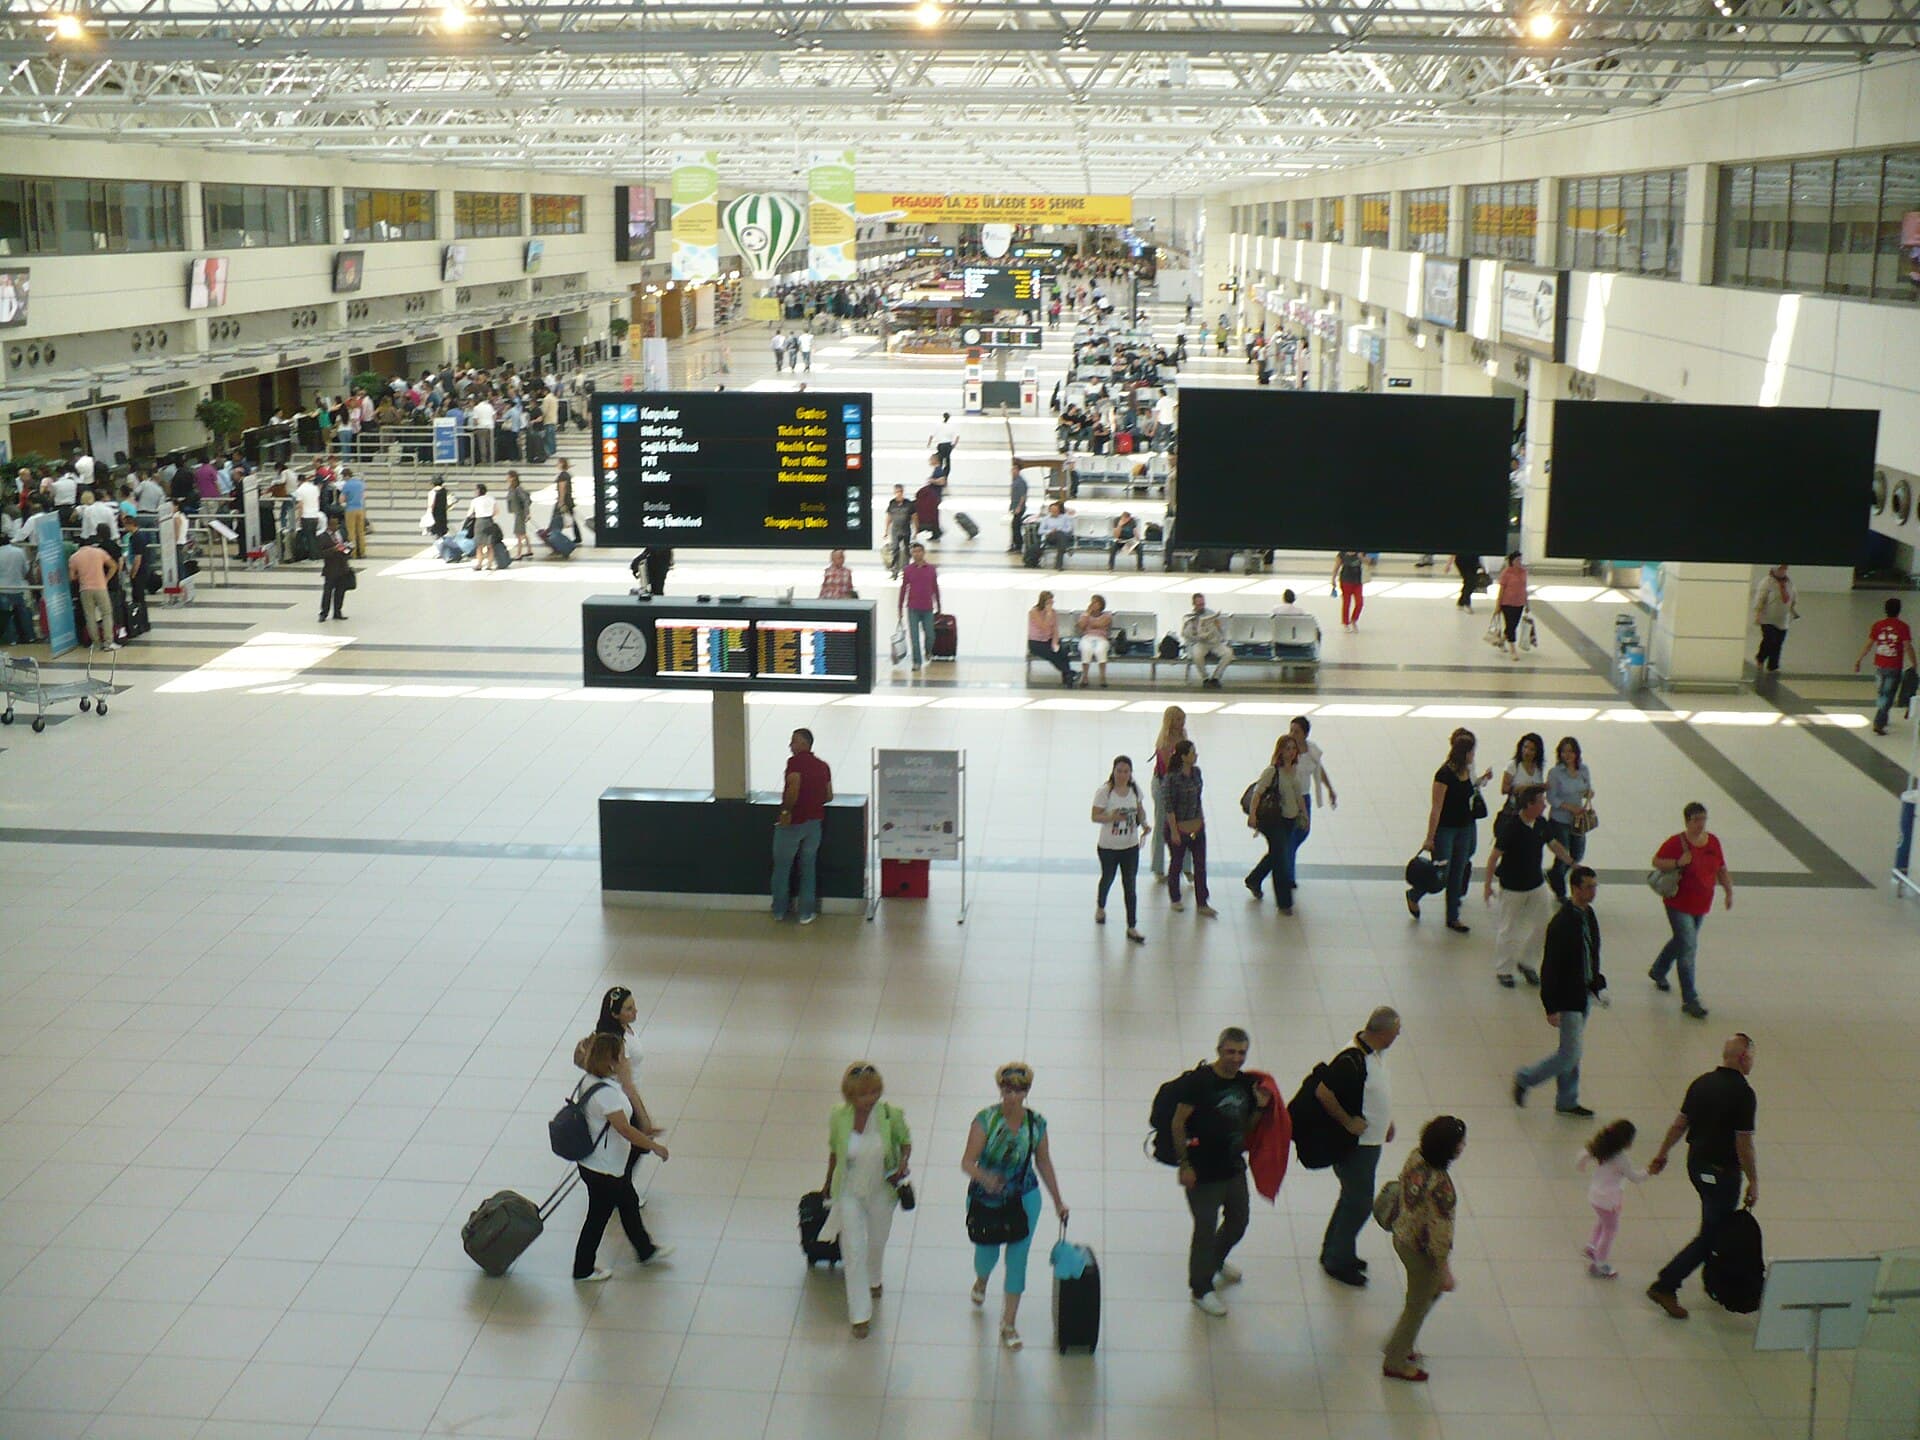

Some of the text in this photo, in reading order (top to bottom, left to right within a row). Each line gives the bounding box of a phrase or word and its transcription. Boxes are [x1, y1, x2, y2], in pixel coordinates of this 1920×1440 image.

[963, 197, 980, 209] 25
[1030, 197, 1046, 209] 58
[1048, 197, 1084, 210] ŞEHRE
[796, 407, 828, 420] Gates
[777, 425, 828, 437] Ticket Sales
[776, 441, 828, 452] Health Care
[781, 456, 828, 467] Post Office
[764, 516, 829, 530] Shopping Units
